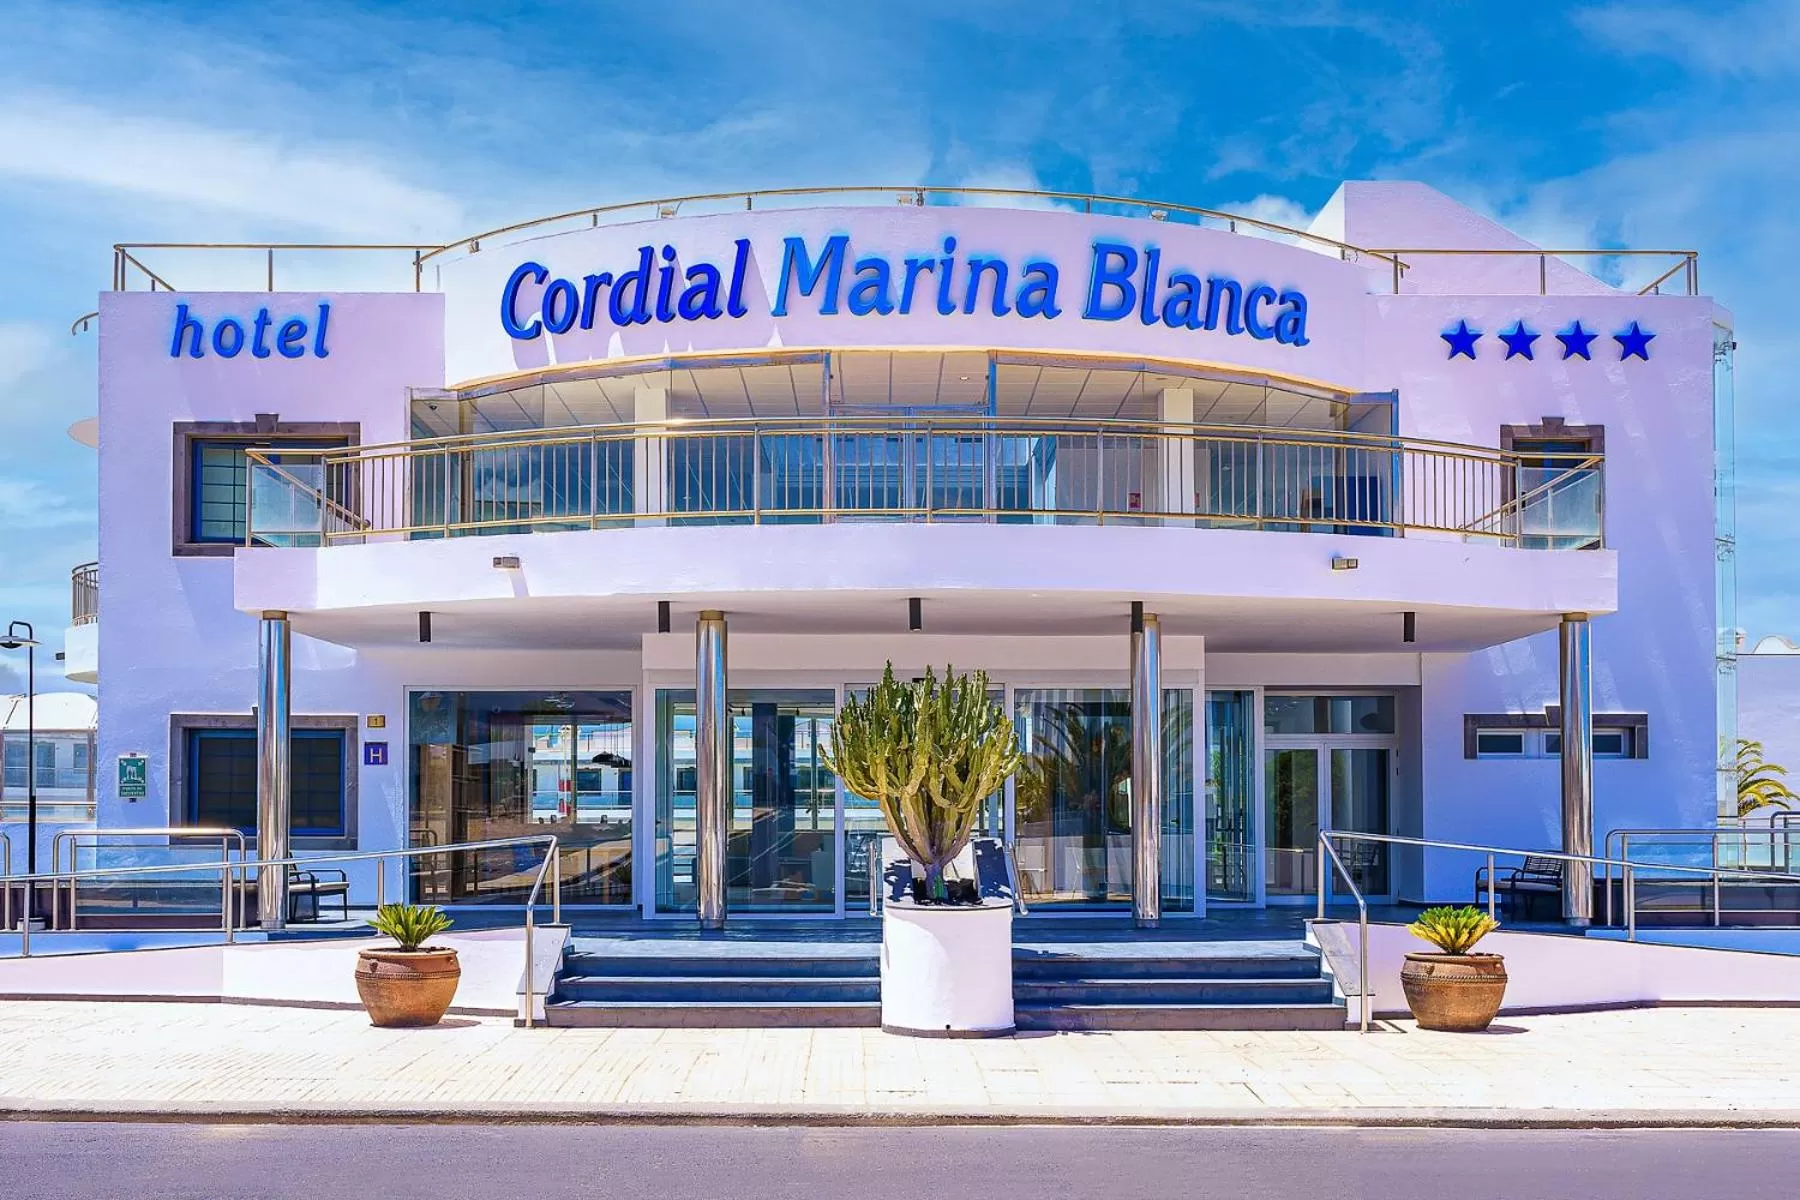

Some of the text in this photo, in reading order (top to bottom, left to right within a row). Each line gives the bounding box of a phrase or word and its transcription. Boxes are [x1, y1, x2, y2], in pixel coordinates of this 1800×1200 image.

[501, 235, 1310, 347] Cordial Marina Blanca
[170, 304, 330, 359] hotel
[370, 748, 382, 763] H
